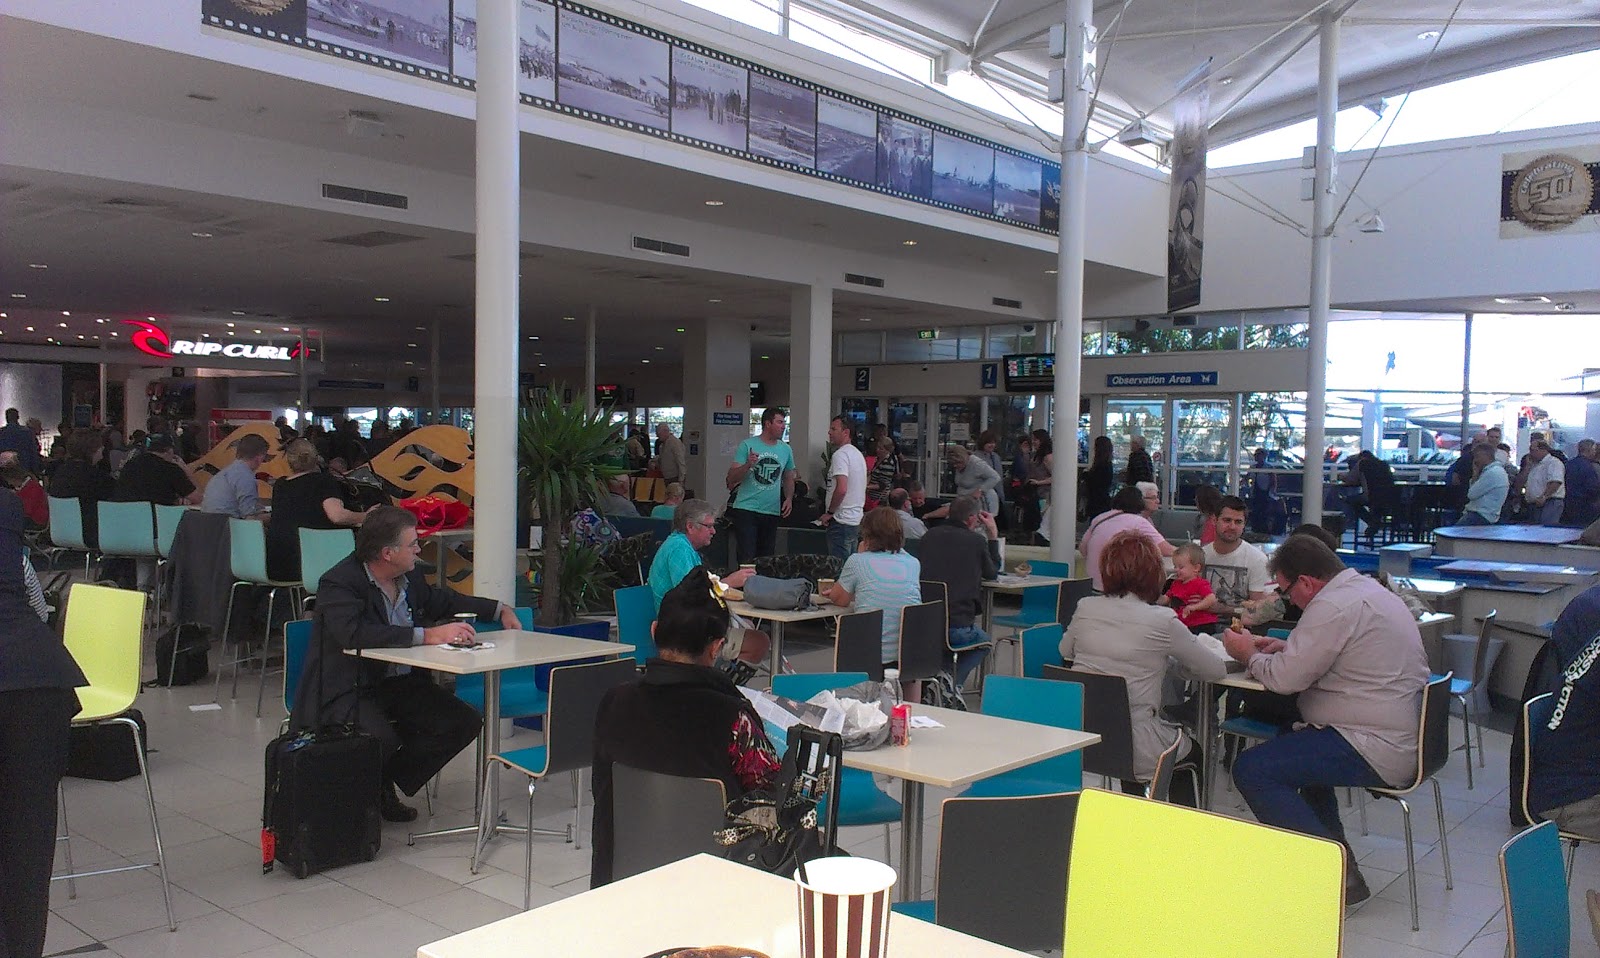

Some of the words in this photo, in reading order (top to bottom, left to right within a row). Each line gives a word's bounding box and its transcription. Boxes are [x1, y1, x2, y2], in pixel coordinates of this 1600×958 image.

[172, 340, 222, 355] RIP
[223, 344, 291, 360] CURL
[858, 369, 867, 382] 2
[985, 366, 993, 379] 1
[1112, 375, 1165, 385] Observation
[1168, 374, 1192, 384] Area
